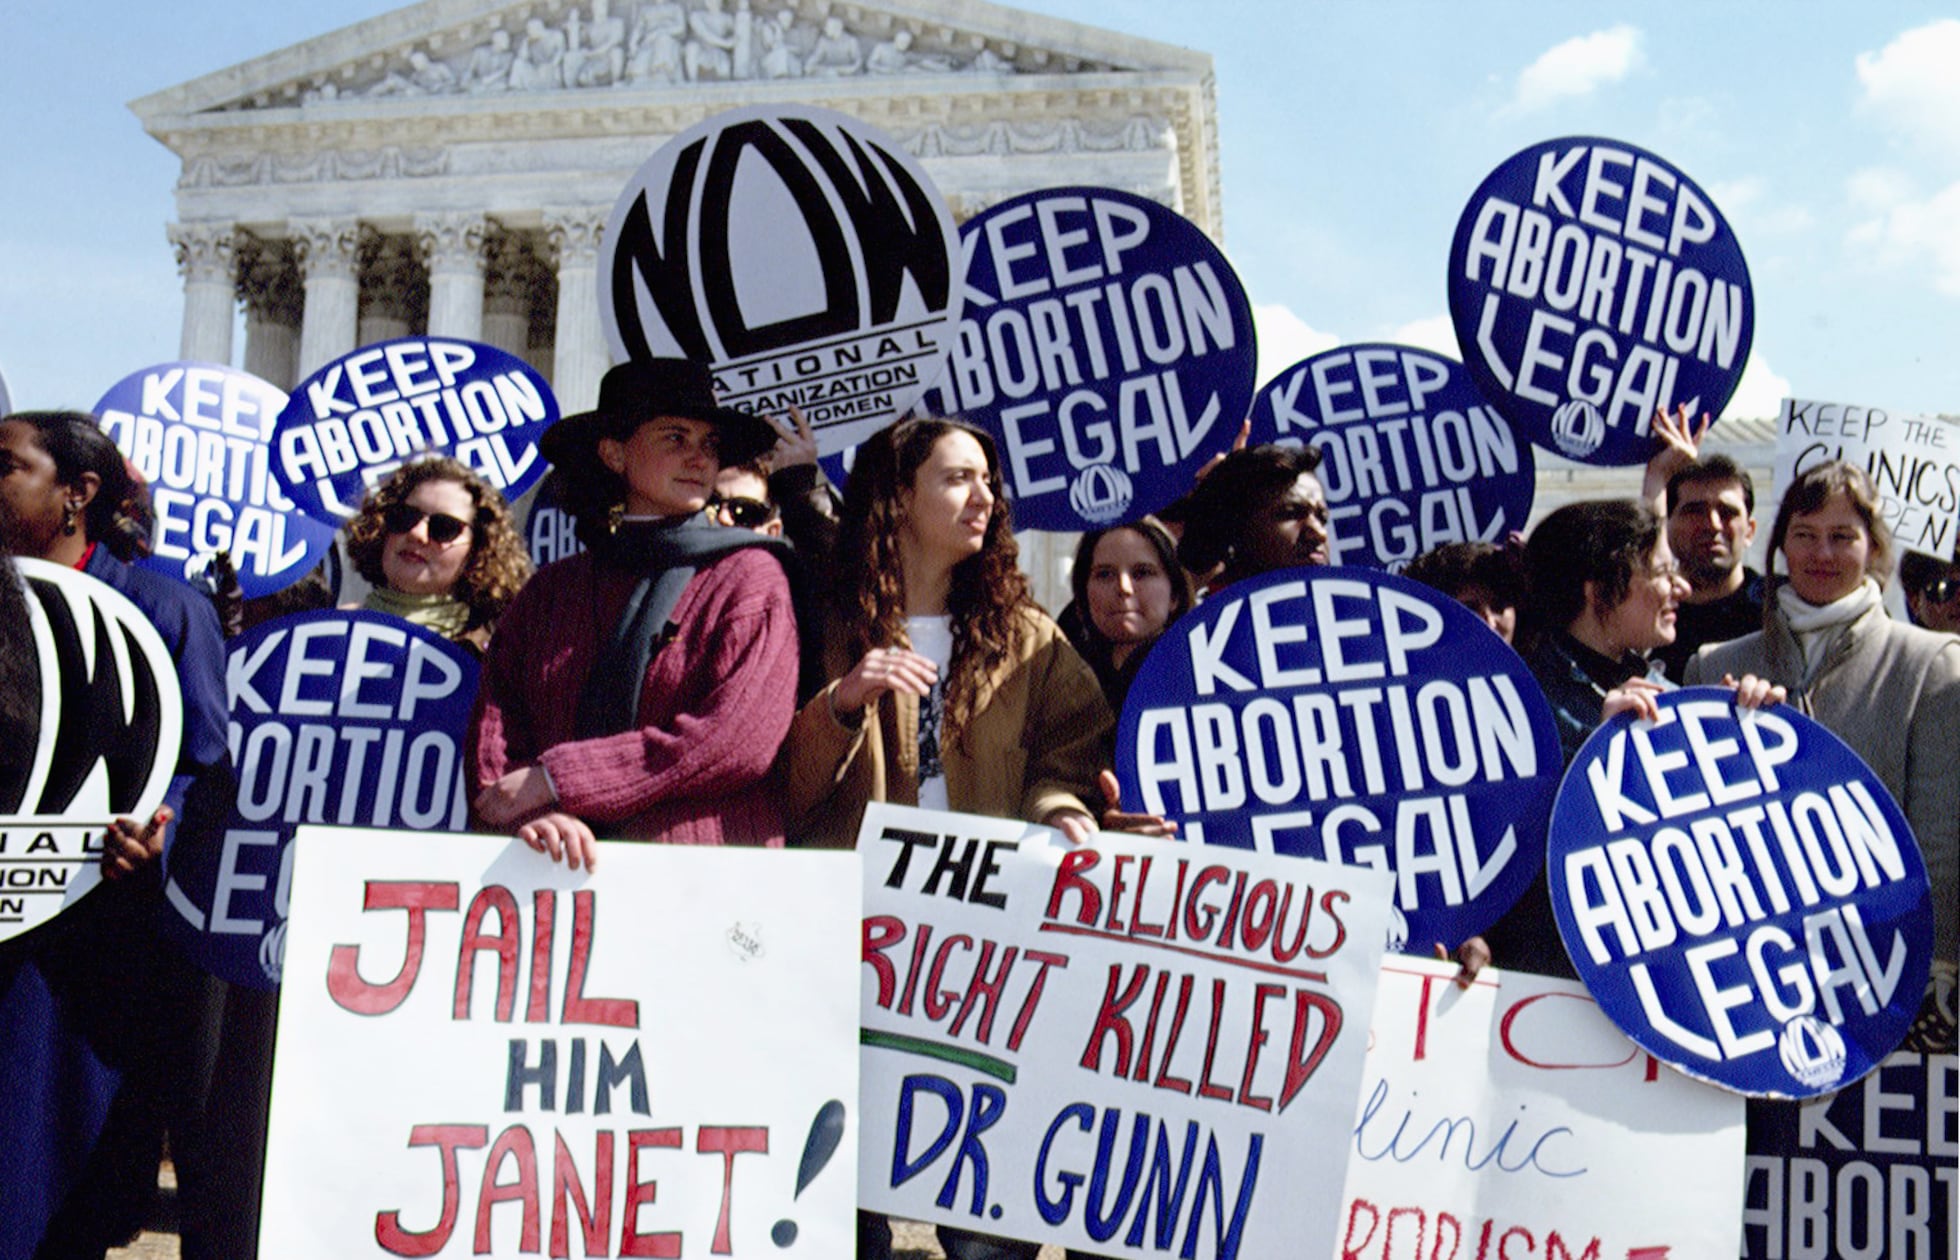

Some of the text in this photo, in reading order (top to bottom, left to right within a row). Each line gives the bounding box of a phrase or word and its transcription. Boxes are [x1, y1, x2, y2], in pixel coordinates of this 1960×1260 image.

[612, 117, 950, 363] NOW
[1532, 146, 1717, 257] KEEP
[1465, 197, 1743, 370] ABORTION
[280, 370, 546, 485] ABORTION
[307, 342, 476, 420] KEEP
[725, 363, 917, 415] GANIZATION
[1270, 349, 1450, 434] KEEP
[1477, 293, 1700, 438] LEGAL
[1786, 398, 1948, 449] KEEP THE
[1001, 370, 1221, 499] EGAL
[1275, 405, 1518, 502] ORTION
[226, 619, 462, 721] KEEP
[1188, 578, 1444, 695] KEEP
[1136, 674, 1537, 816] ABORTION
[1587, 701, 1799, 833] KEEP
[880, 827, 1019, 910] THE
[1044, 848, 1352, 963] RELIGIOUS
[1564, 780, 1906, 966] ABORTION
[326, 879, 641, 1030] JAIL
[861, 915, 1343, 1115] RIGHT KILLED
[1629, 903, 1907, 1062] LEGAL
[503, 1037, 653, 1117] HIM
[890, 1073, 1265, 1260] DR. GUNN
